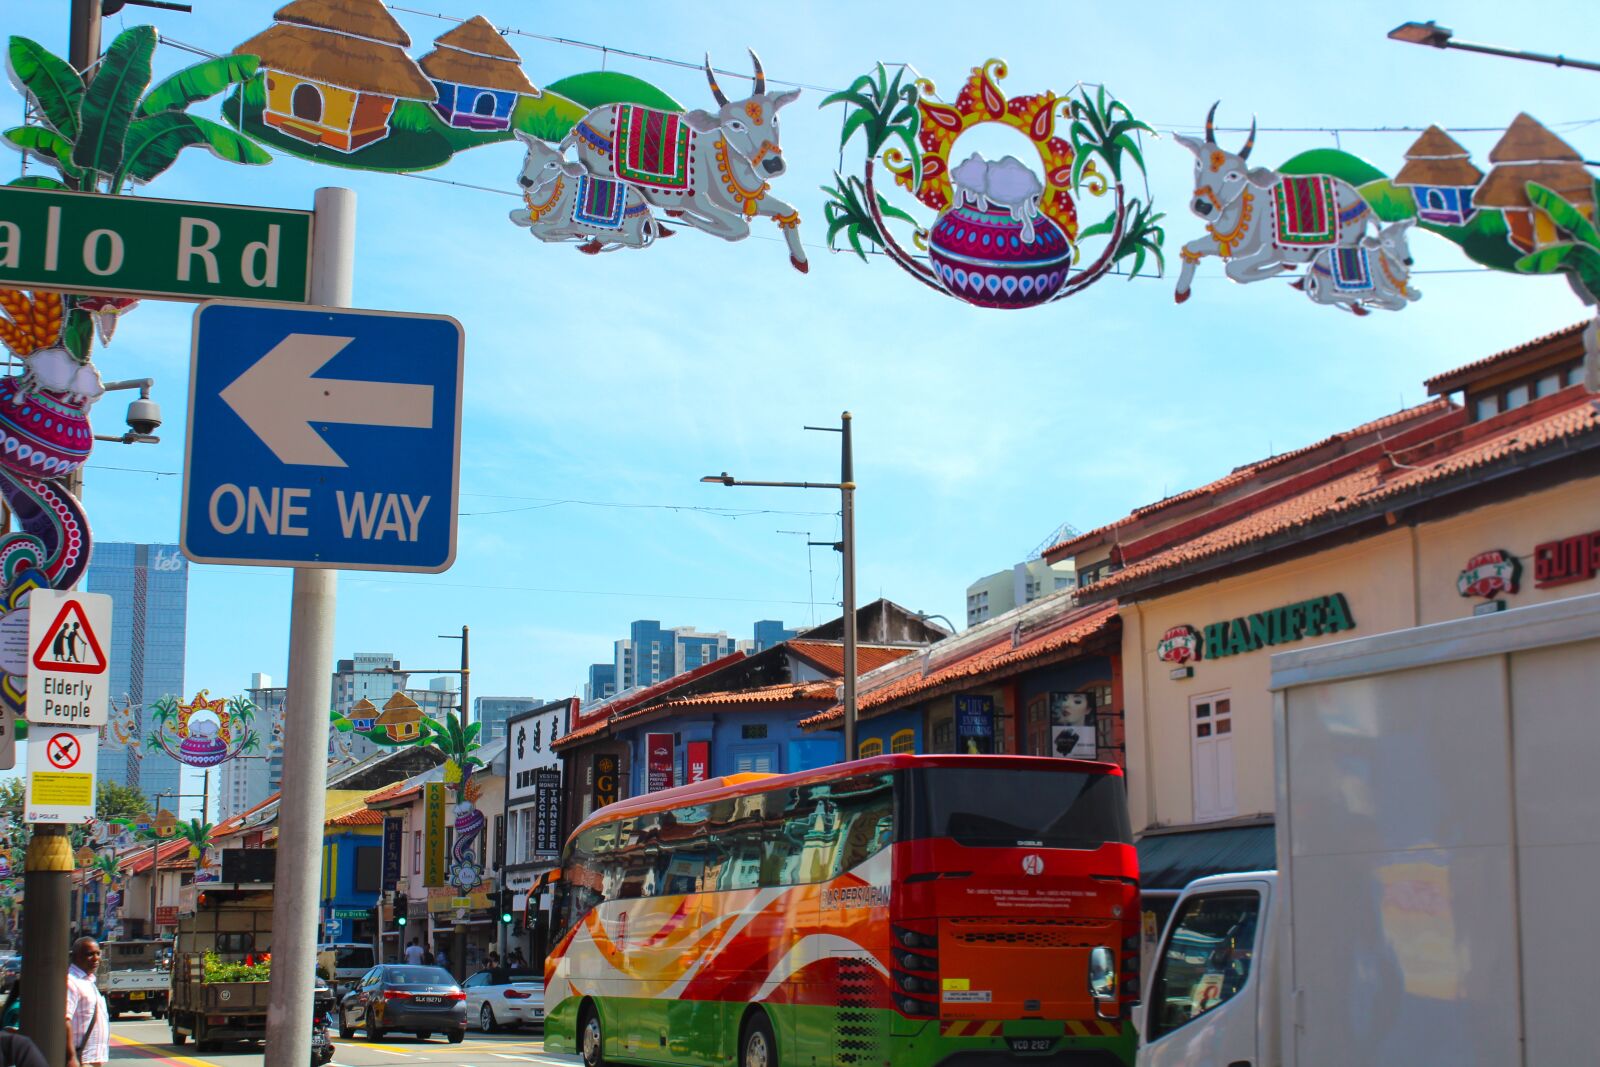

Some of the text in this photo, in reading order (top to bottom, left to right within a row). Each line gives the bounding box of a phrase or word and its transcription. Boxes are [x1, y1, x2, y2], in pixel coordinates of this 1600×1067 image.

[176, 216, 281, 289] Rd
[208, 482, 431, 543] ONE WAY
[1204, 592, 1354, 660] HANIFFA
[44, 677, 92, 701] Elderly
[45, 699, 90, 721] People
[430, 784, 440, 836] KOMALA
[538, 789, 546, 849] EXCHANGE
[549, 789, 558, 849] TRANSFER
